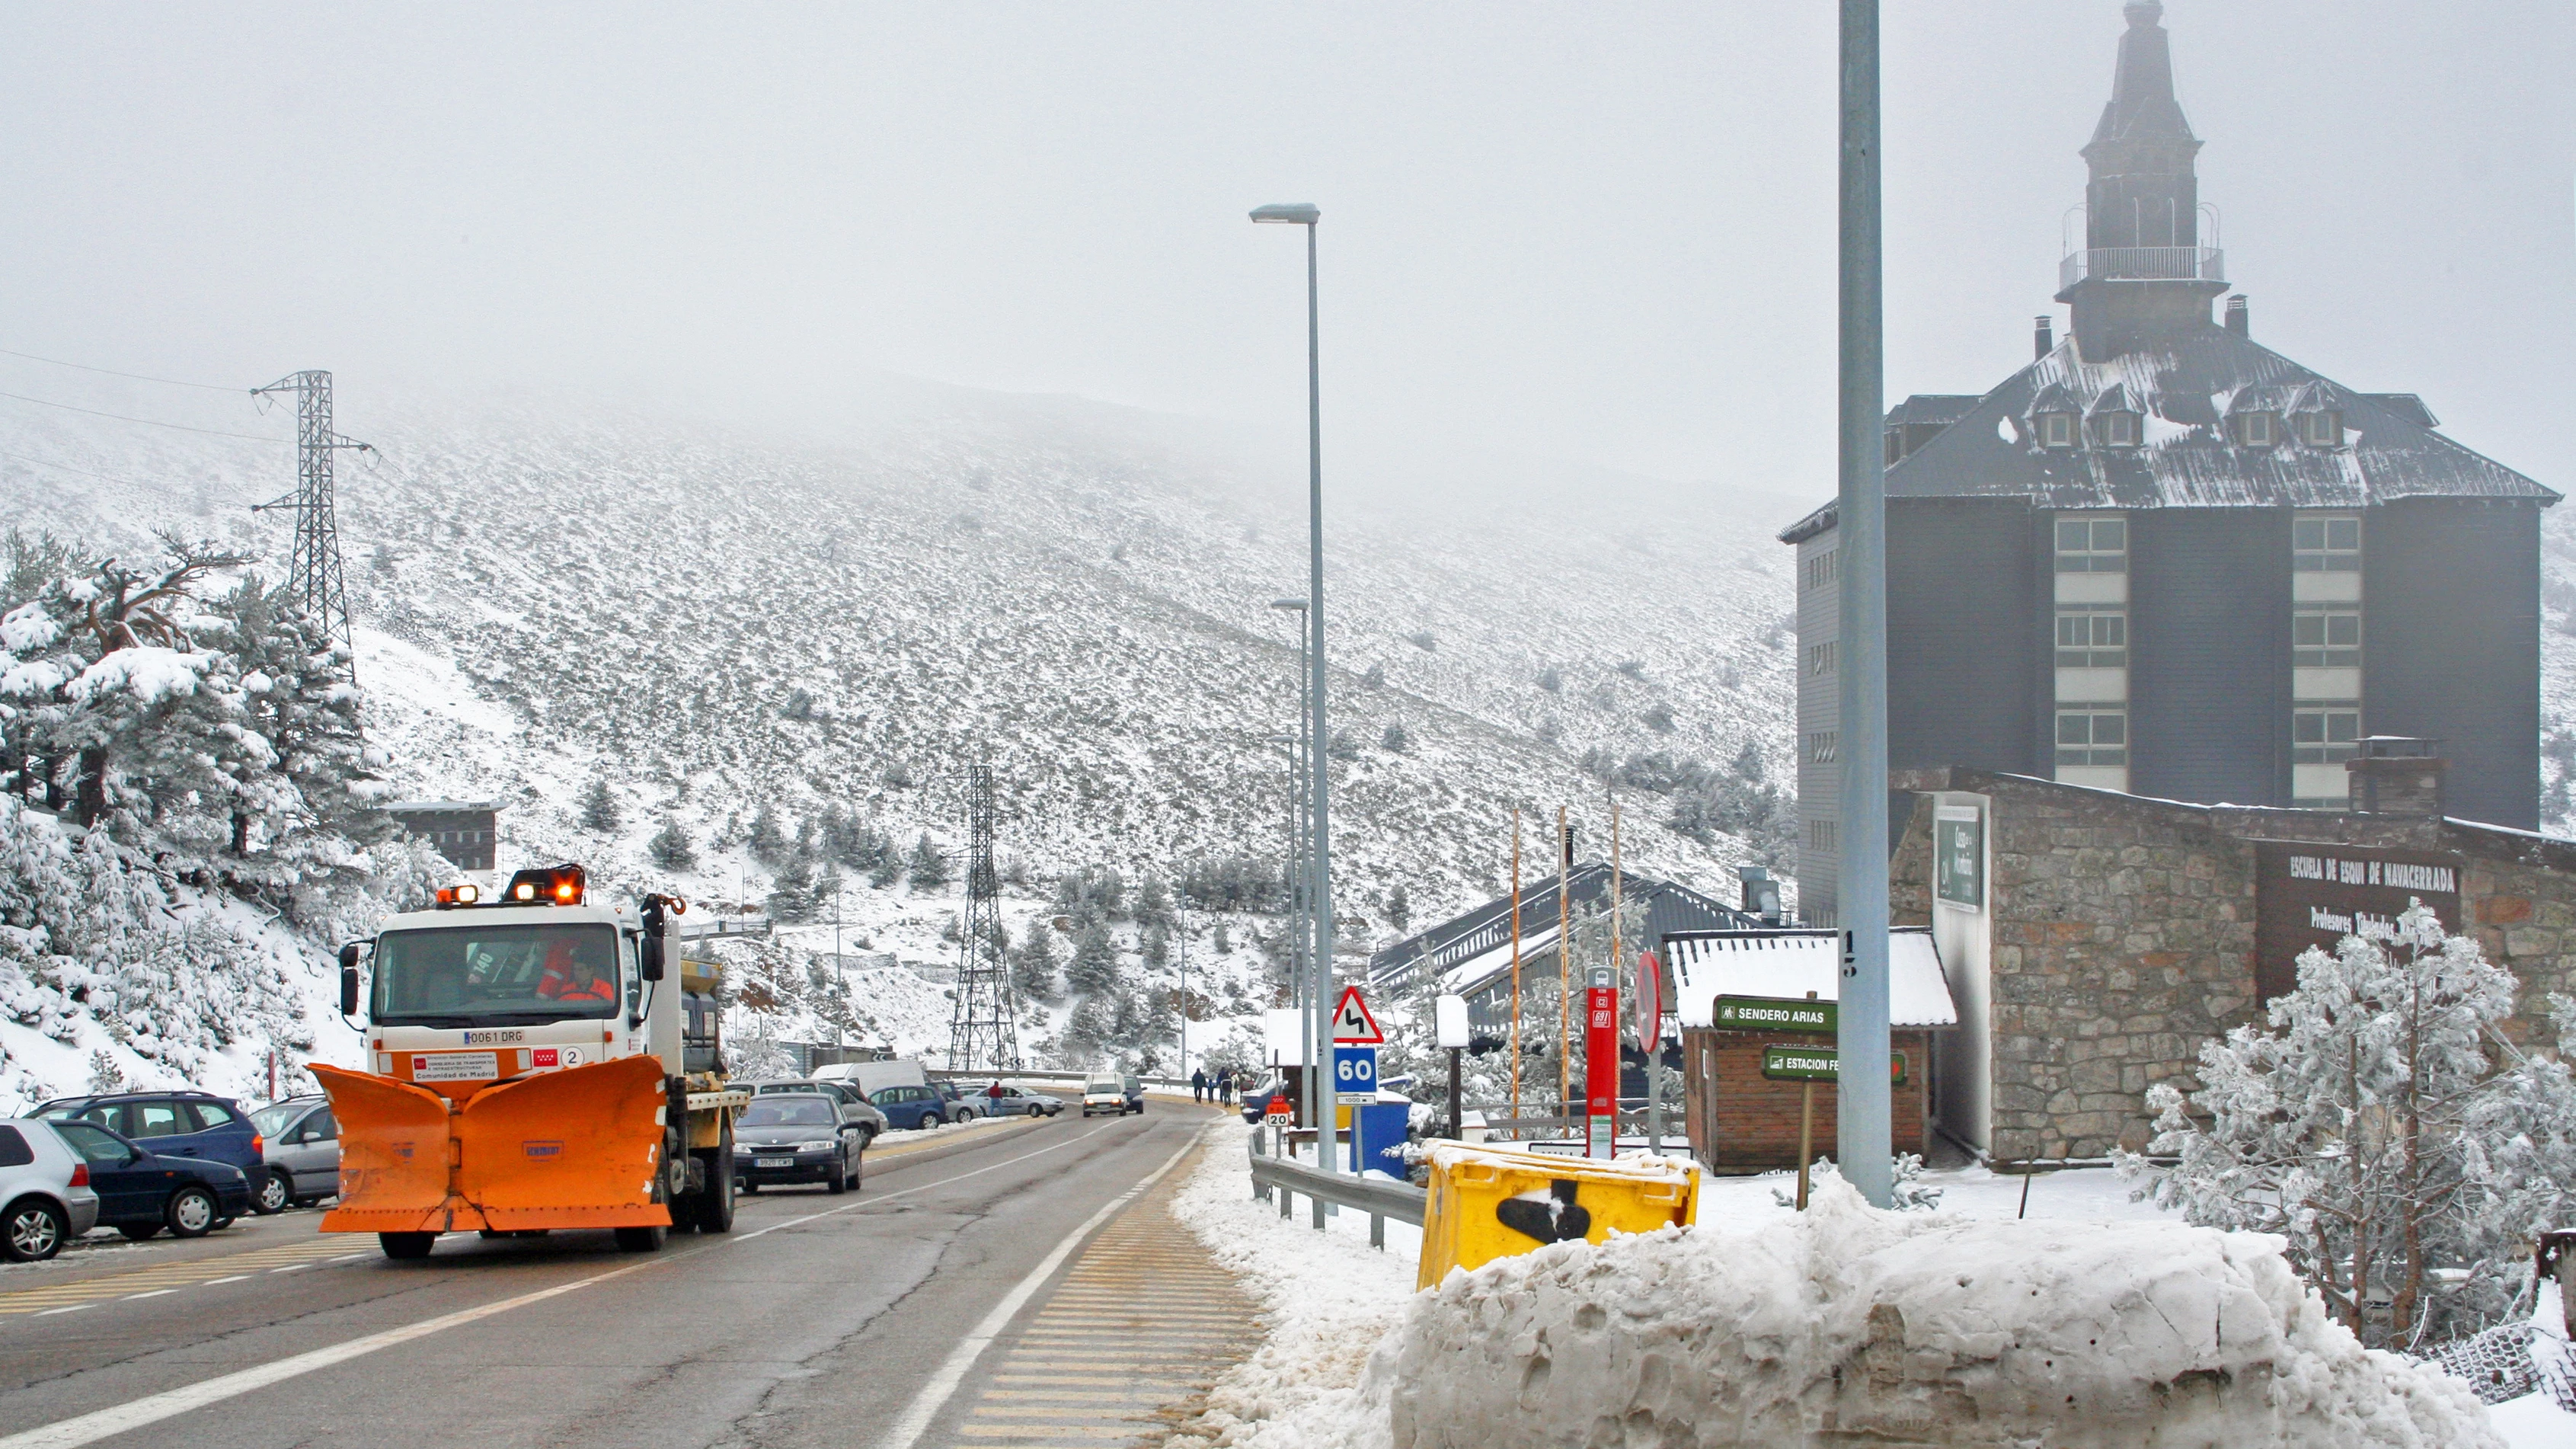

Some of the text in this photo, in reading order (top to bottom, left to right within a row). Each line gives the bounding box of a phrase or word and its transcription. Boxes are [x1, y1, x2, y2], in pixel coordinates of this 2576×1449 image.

[2290, 856, 2455, 893] ESCUELA DE ESQUI DE NAVACERRADA
[2311, 906, 2352, 933] Profesores
[1595, 1012, 1609, 1022] 691
[1738, 1008, 1824, 1023] SENDERO ARIAS
[471, 1031, 523, 1043] 0061 DRG
[567, 1051, 577, 1064] 2
[1786, 1057, 1827, 1070] ESTACION
[1338, 1059, 1372, 1081] 60
[1270, 1115, 1286, 1124] 20
